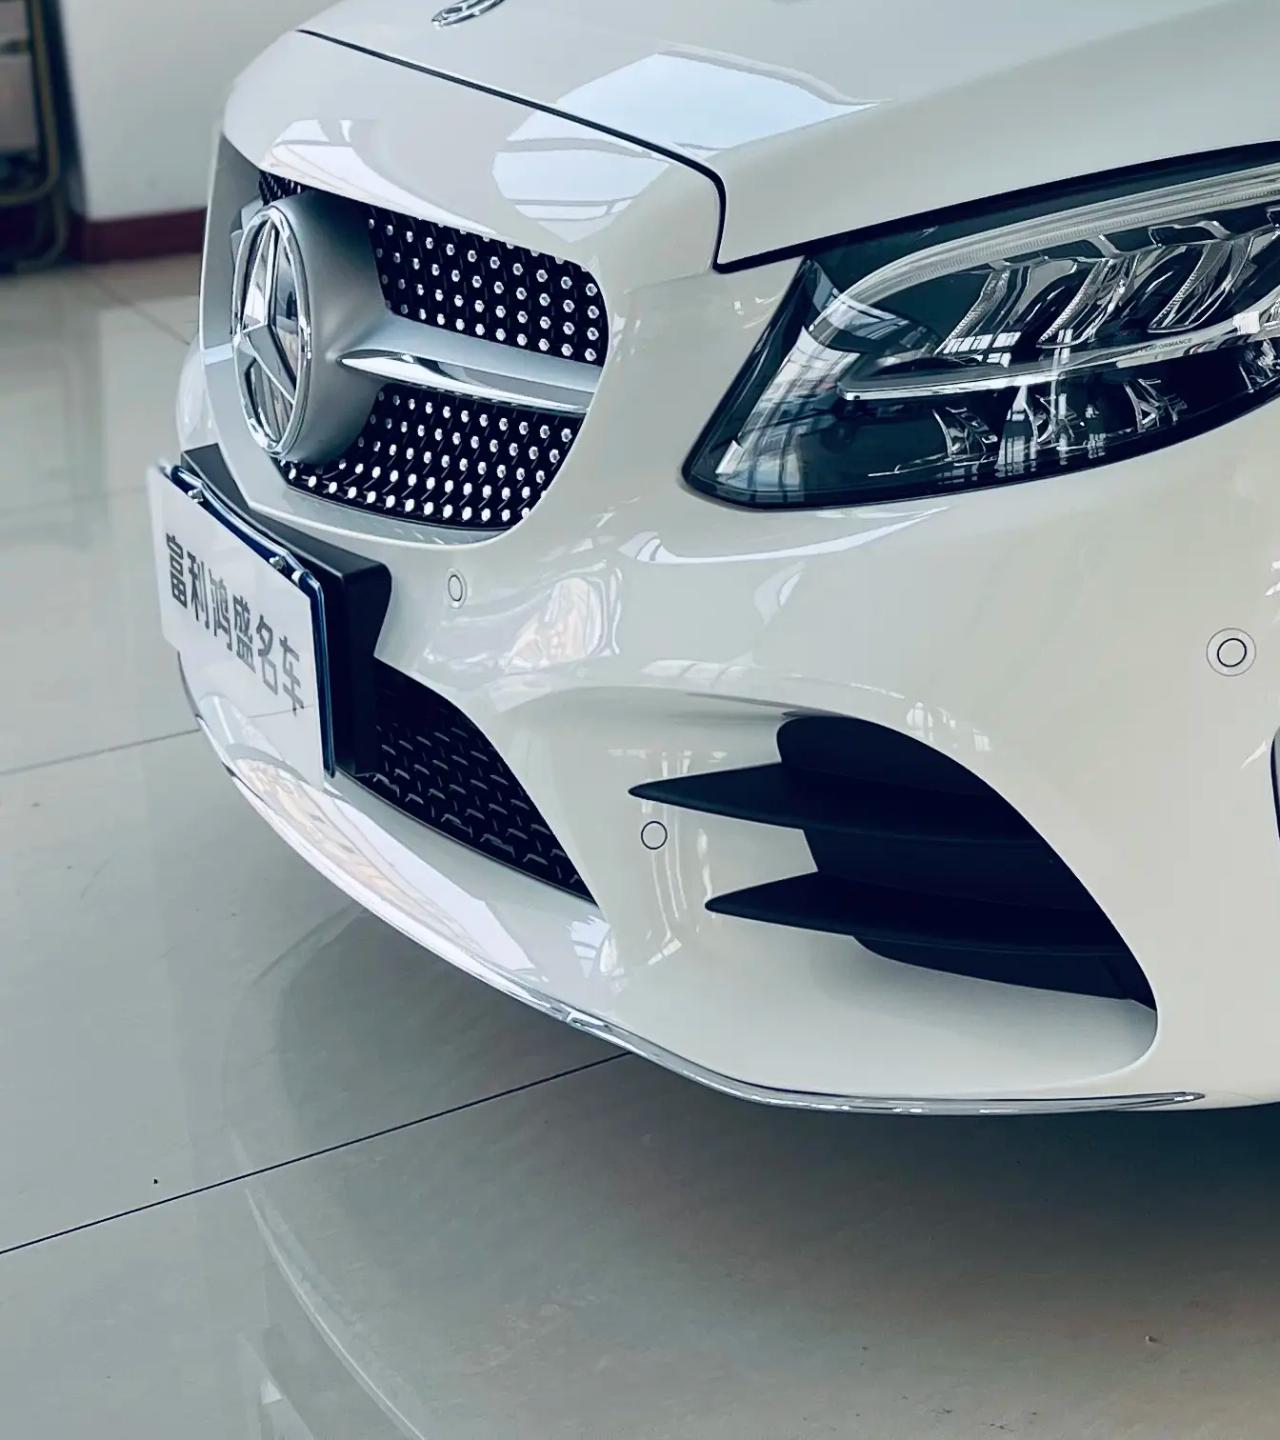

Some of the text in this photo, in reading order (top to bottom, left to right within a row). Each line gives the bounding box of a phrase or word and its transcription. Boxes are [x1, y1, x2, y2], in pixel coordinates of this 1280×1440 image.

[165, 533, 304, 716] 富利鸿盛名车
